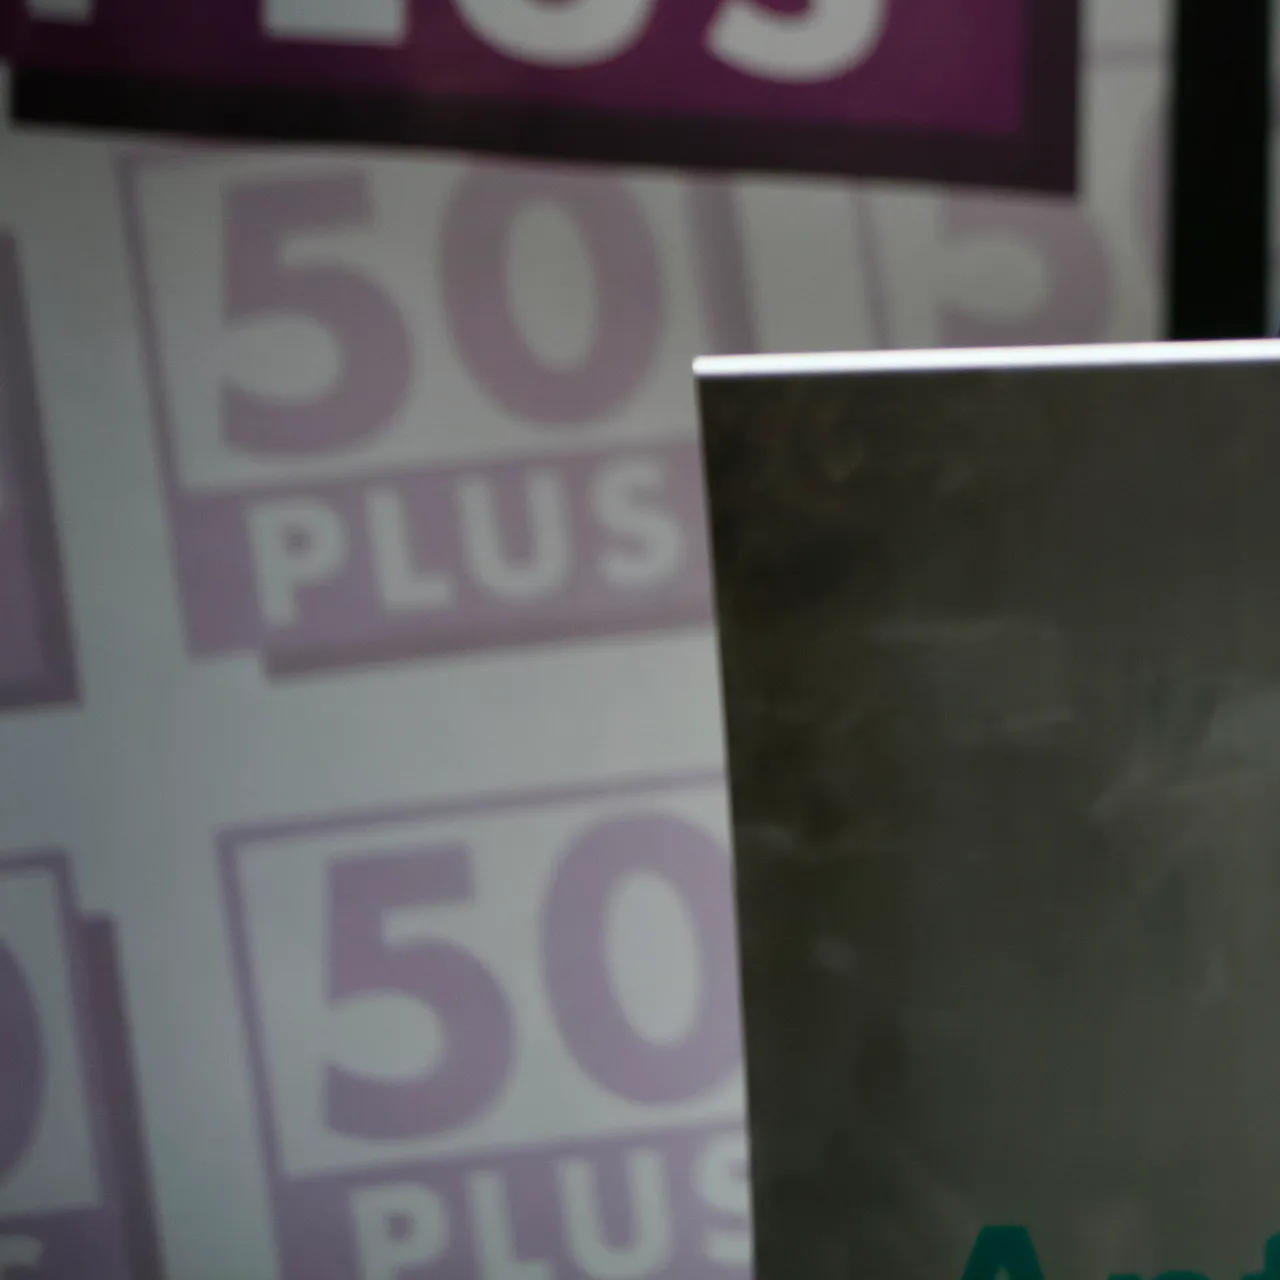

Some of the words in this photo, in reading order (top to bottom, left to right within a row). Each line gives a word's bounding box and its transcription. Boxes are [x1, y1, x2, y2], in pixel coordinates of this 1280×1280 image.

[220, 160, 668, 462] 50
[246, 456, 688, 626] PLUS
[323, 812, 742, 1140] 50
